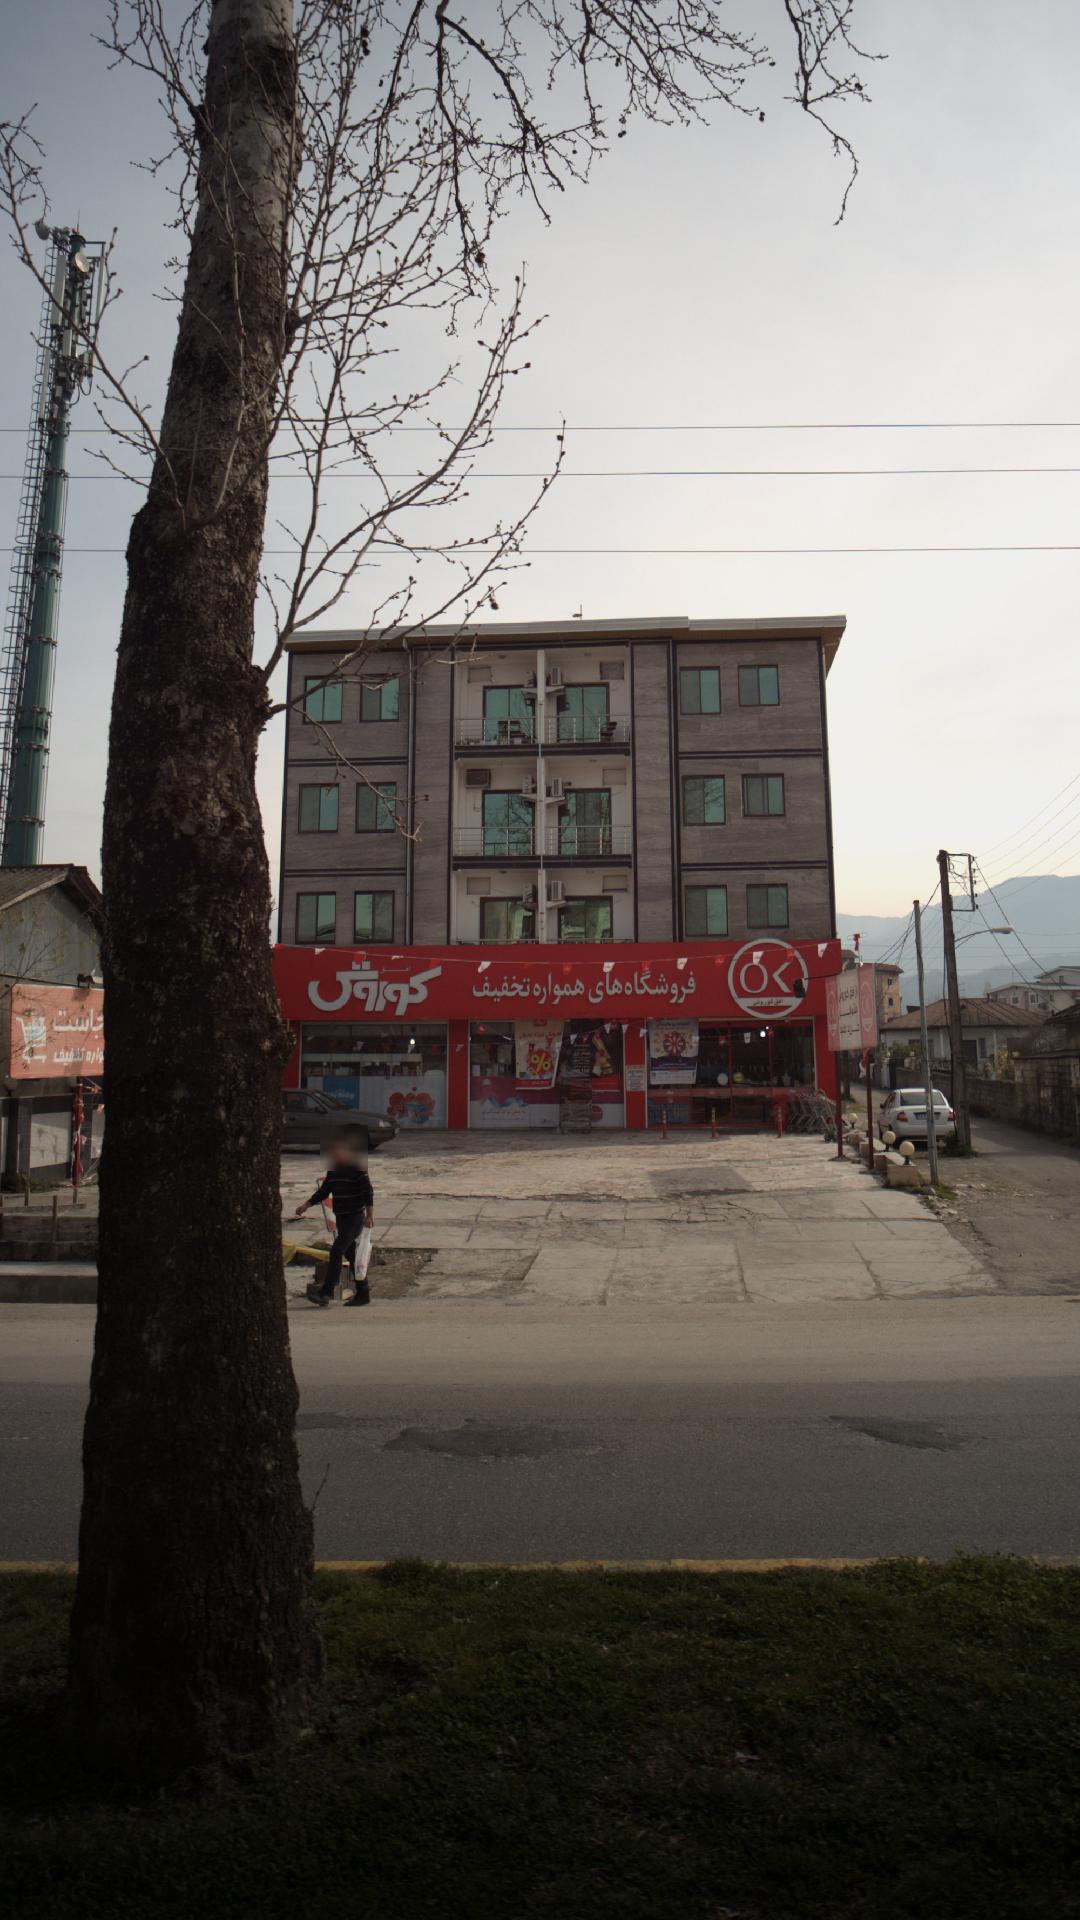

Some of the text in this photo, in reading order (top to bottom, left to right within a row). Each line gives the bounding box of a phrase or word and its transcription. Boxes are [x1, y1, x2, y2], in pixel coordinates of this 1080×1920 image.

[472, 975, 531, 1003] تخفیف
[532, 972, 585, 1004] همواره
[740, 962, 791, 993] OK
